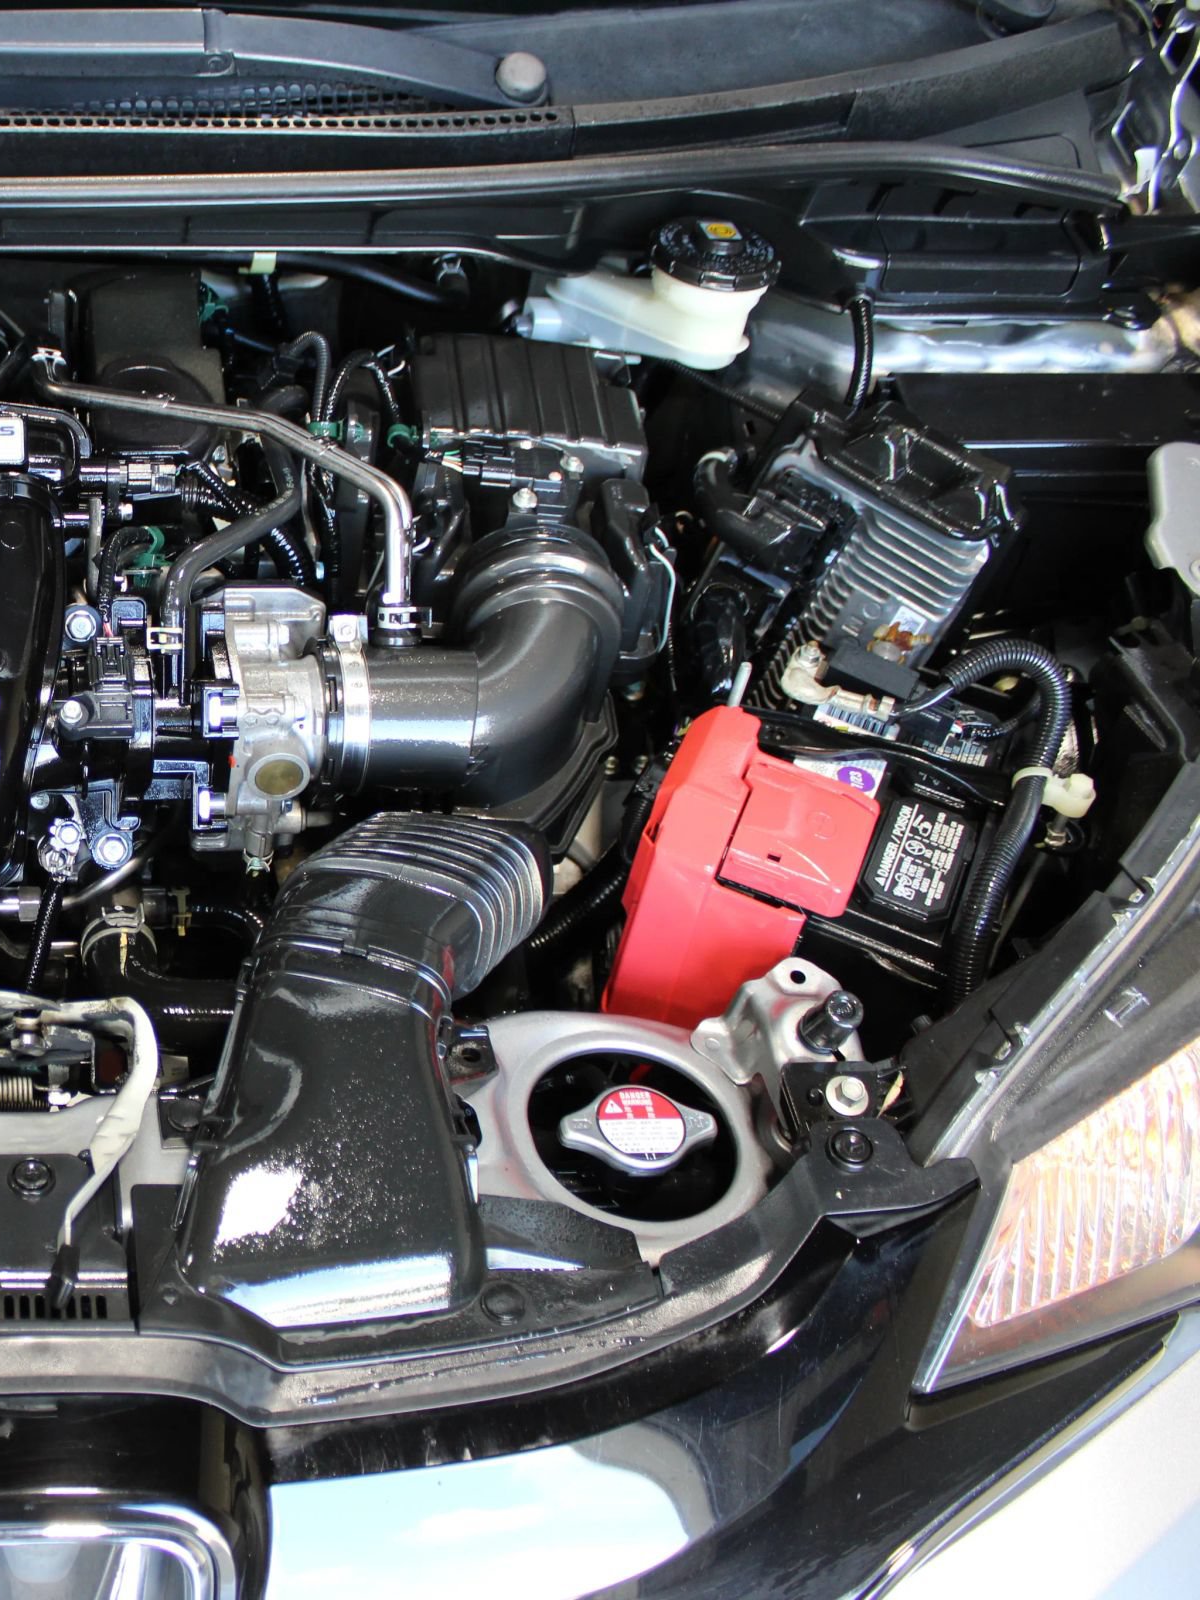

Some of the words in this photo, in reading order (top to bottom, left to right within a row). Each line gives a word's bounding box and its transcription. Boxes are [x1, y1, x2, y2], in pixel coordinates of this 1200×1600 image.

[877, 841, 899, 877] DANGER
[892, 804, 913, 837] POISON
[619, 1091, 651, 1100] DANGER
